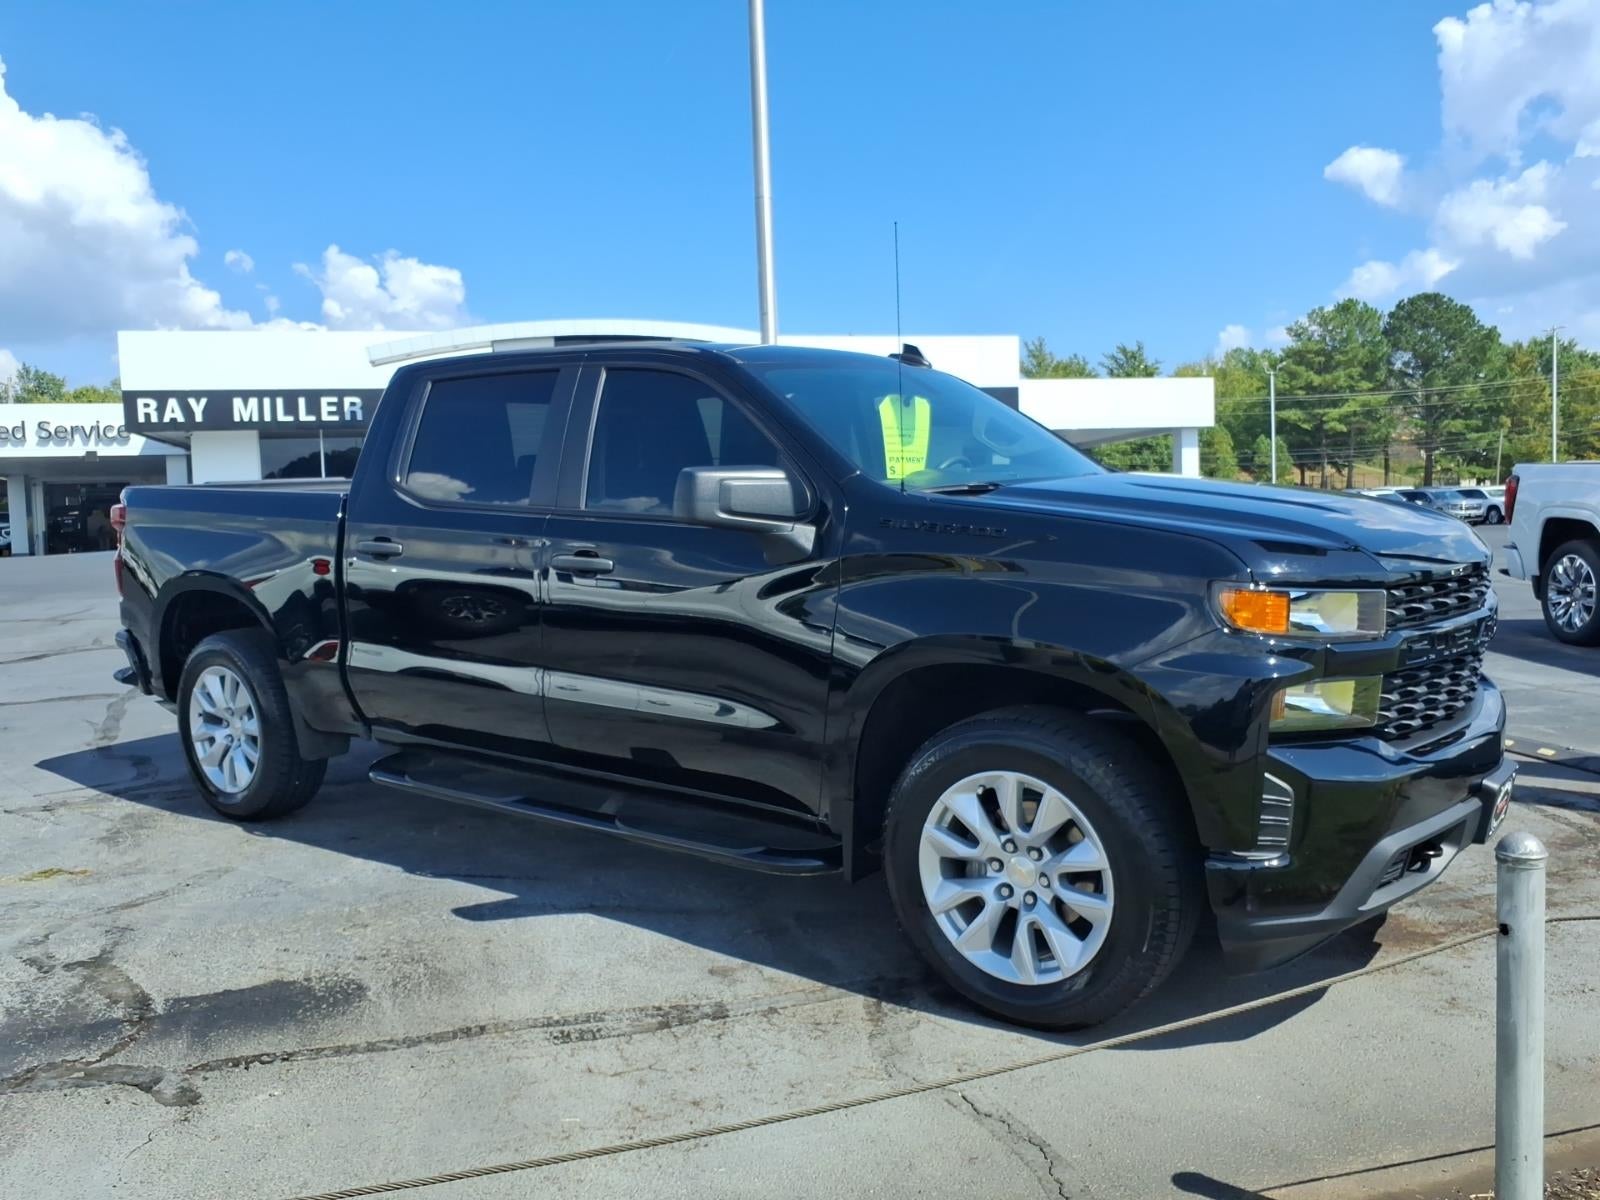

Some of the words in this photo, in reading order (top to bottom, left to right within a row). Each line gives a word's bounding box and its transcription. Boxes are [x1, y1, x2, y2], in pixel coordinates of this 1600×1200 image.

[136, 397, 208, 423] RAY
[232, 396, 363, 422] MILLER
[37, 420, 130, 440] Service
